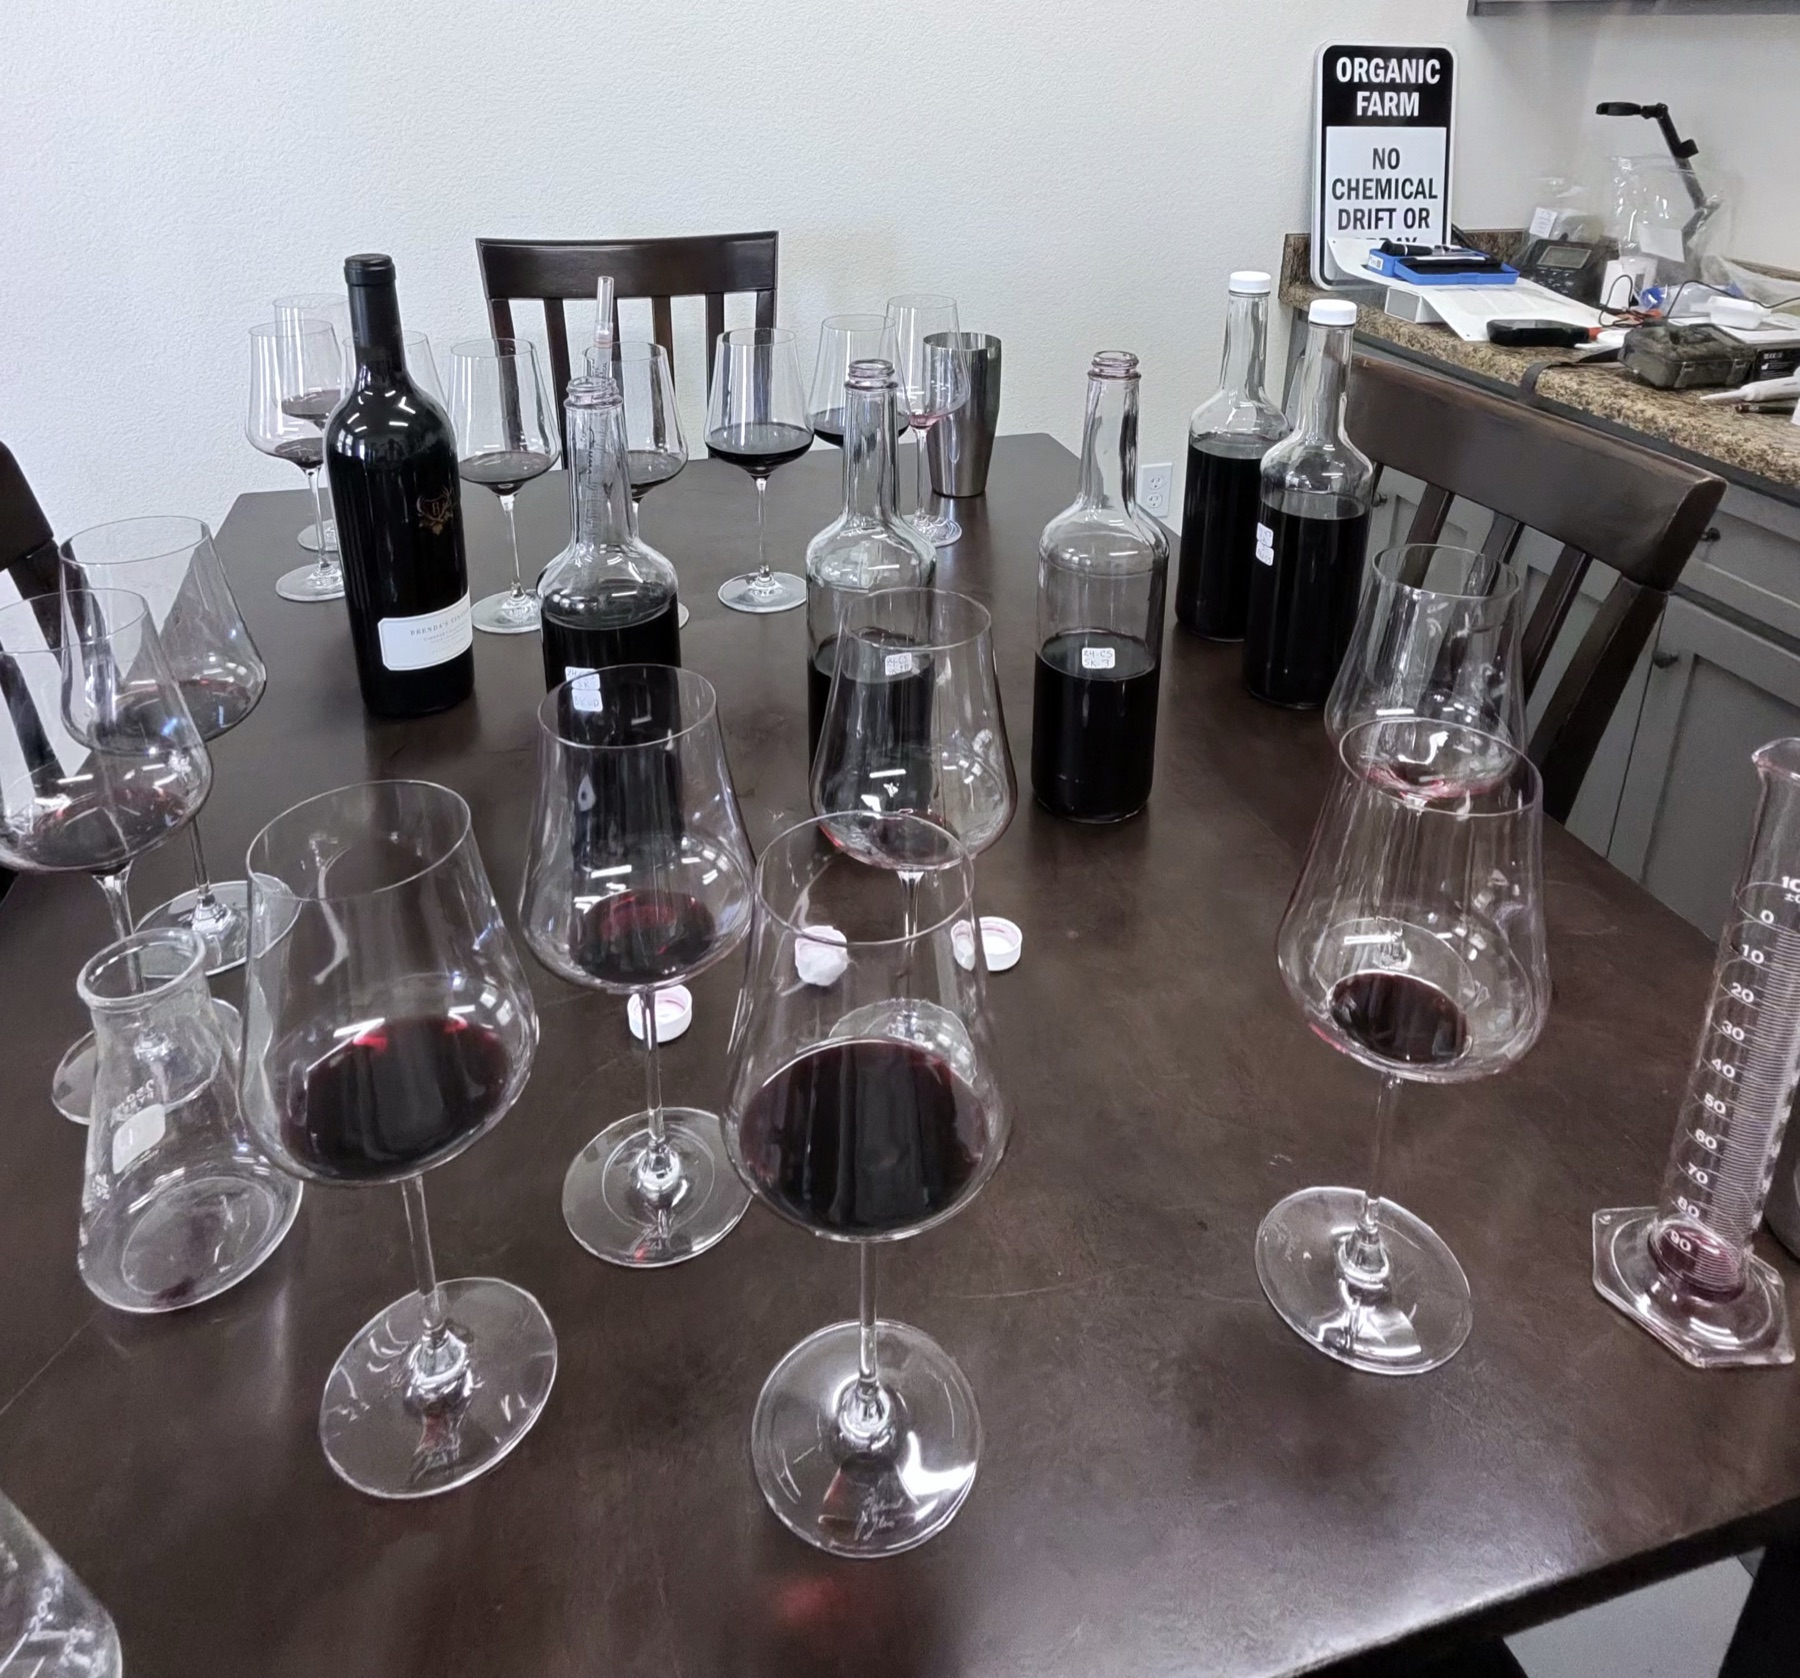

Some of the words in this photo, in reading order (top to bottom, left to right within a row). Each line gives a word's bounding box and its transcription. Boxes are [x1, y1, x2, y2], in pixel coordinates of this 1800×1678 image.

[1336, 57, 1441, 84] ORGANIC
[1356, 91, 1420, 117] FARM
[1372, 148, 1400, 170] NO
[1332, 178, 1438, 201] CHEMICAL
[1338, 208, 1397, 231] DRIFT
[1403, 207, 1430, 229] OR
[1760, 909, 1774, 924] 0
[1742, 944, 1765, 964] 10
[1731, 982, 1754, 1003] 20
[1721, 1020, 1745, 1041] 30
[1711, 1058, 1735, 1078] 40
[1704, 1092, 1726, 1114] 50
[1695, 1128, 1717, 1149] 60
[1687, 1161, 1708, 1184] 70
[1677, 1195, 1699, 1218] 80
[1670, 1230, 1691, 1251] 90
